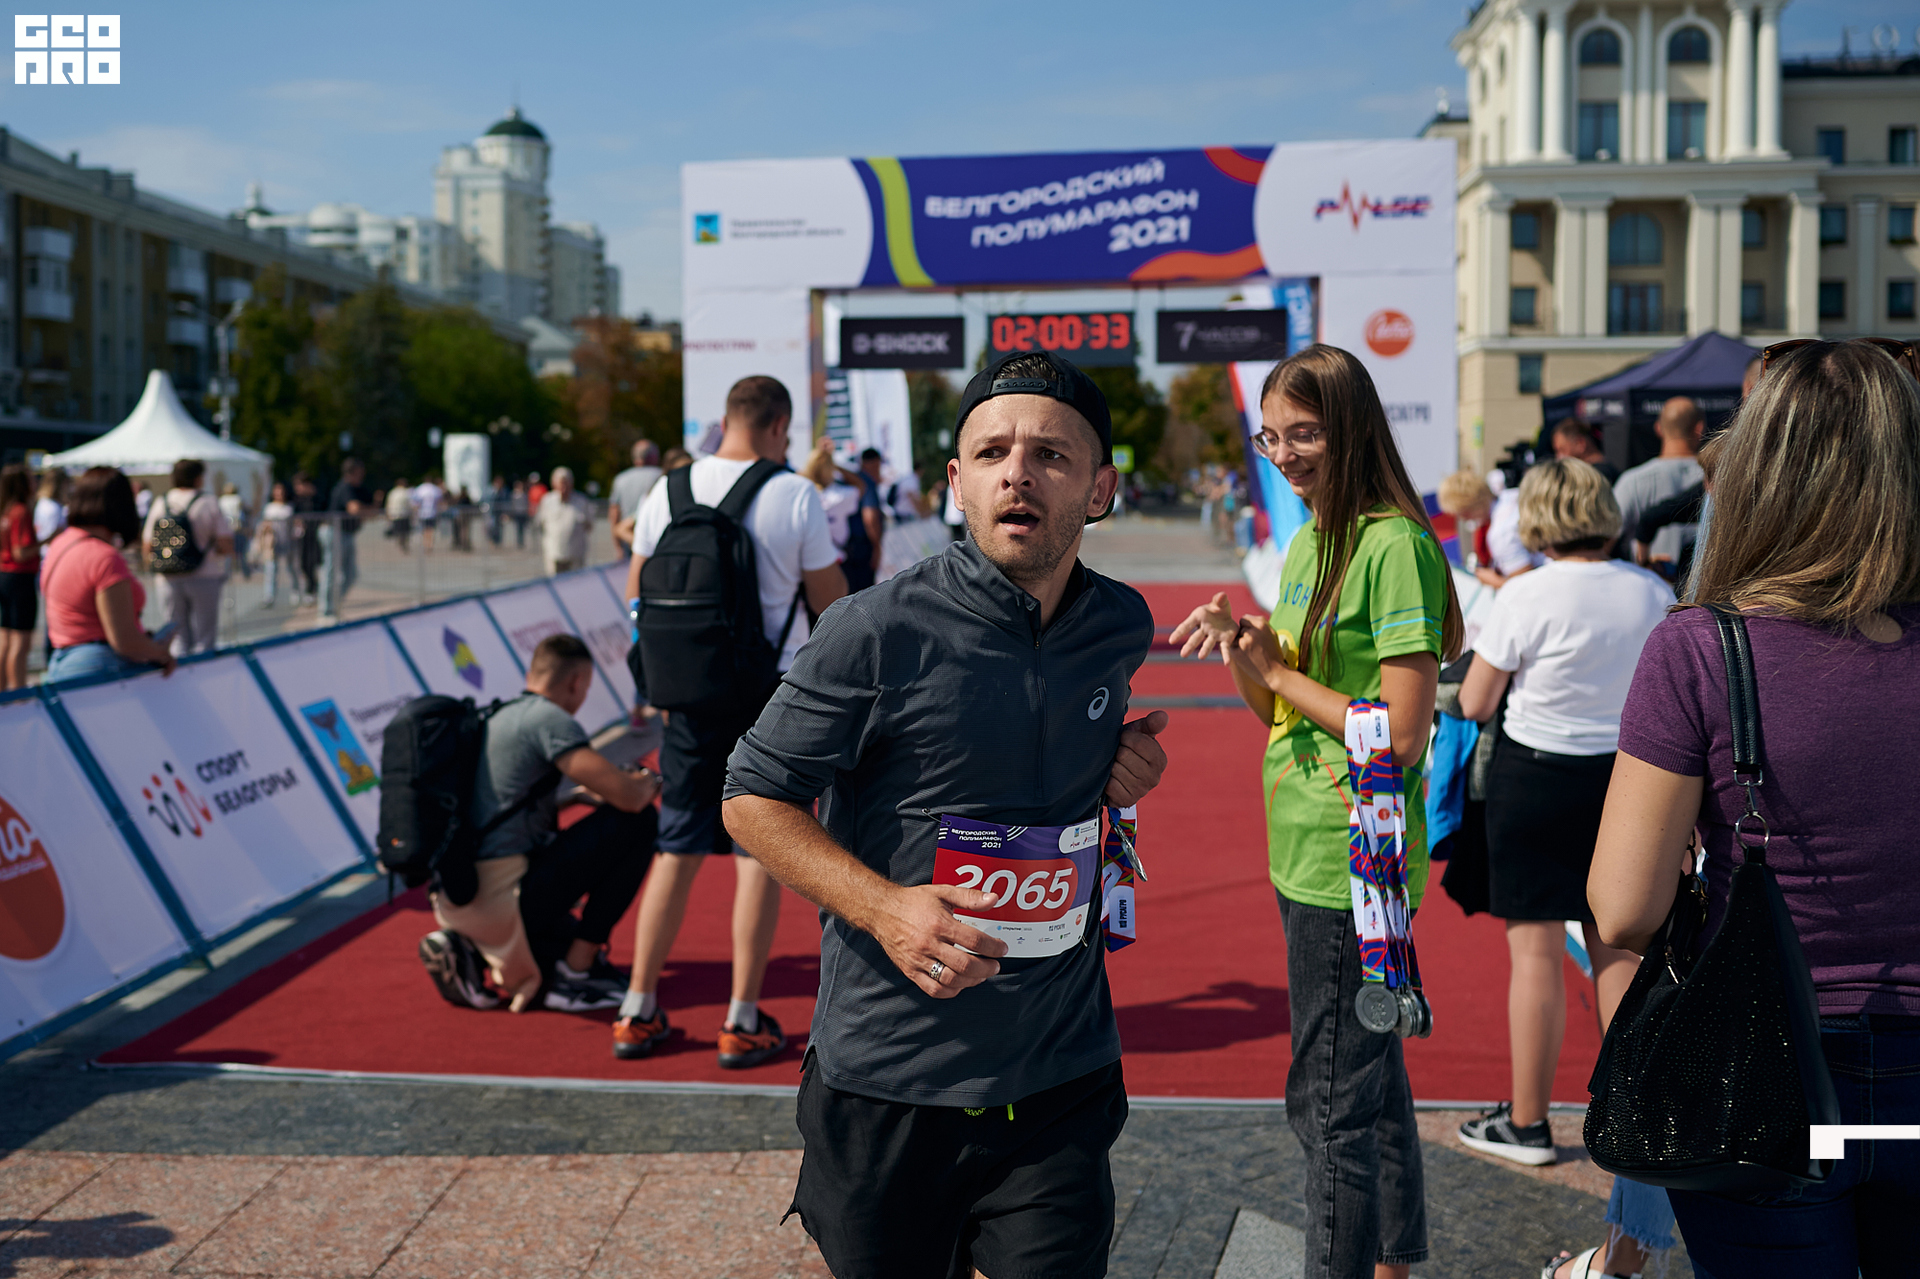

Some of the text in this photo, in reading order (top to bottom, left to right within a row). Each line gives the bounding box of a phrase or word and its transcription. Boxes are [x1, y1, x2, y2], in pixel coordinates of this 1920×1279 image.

[924, 159, 1165, 218] БЕЛГОРОДСКИЙ
[970, 189, 1199, 247] ПОЛУМАРАФОН
[1108, 215, 1191, 253] 2021
[992, 313, 1130, 351] 02:00:33
[196, 750, 249, 784] СПОРТ
[214, 767, 297, 815] БЕЛОГОРЬЯ
[951, 828, 997, 836] БЕЛГОРОДСКИЙ
[981, 841, 1002, 849] 2021
[955, 864, 1073, 910] 2065
